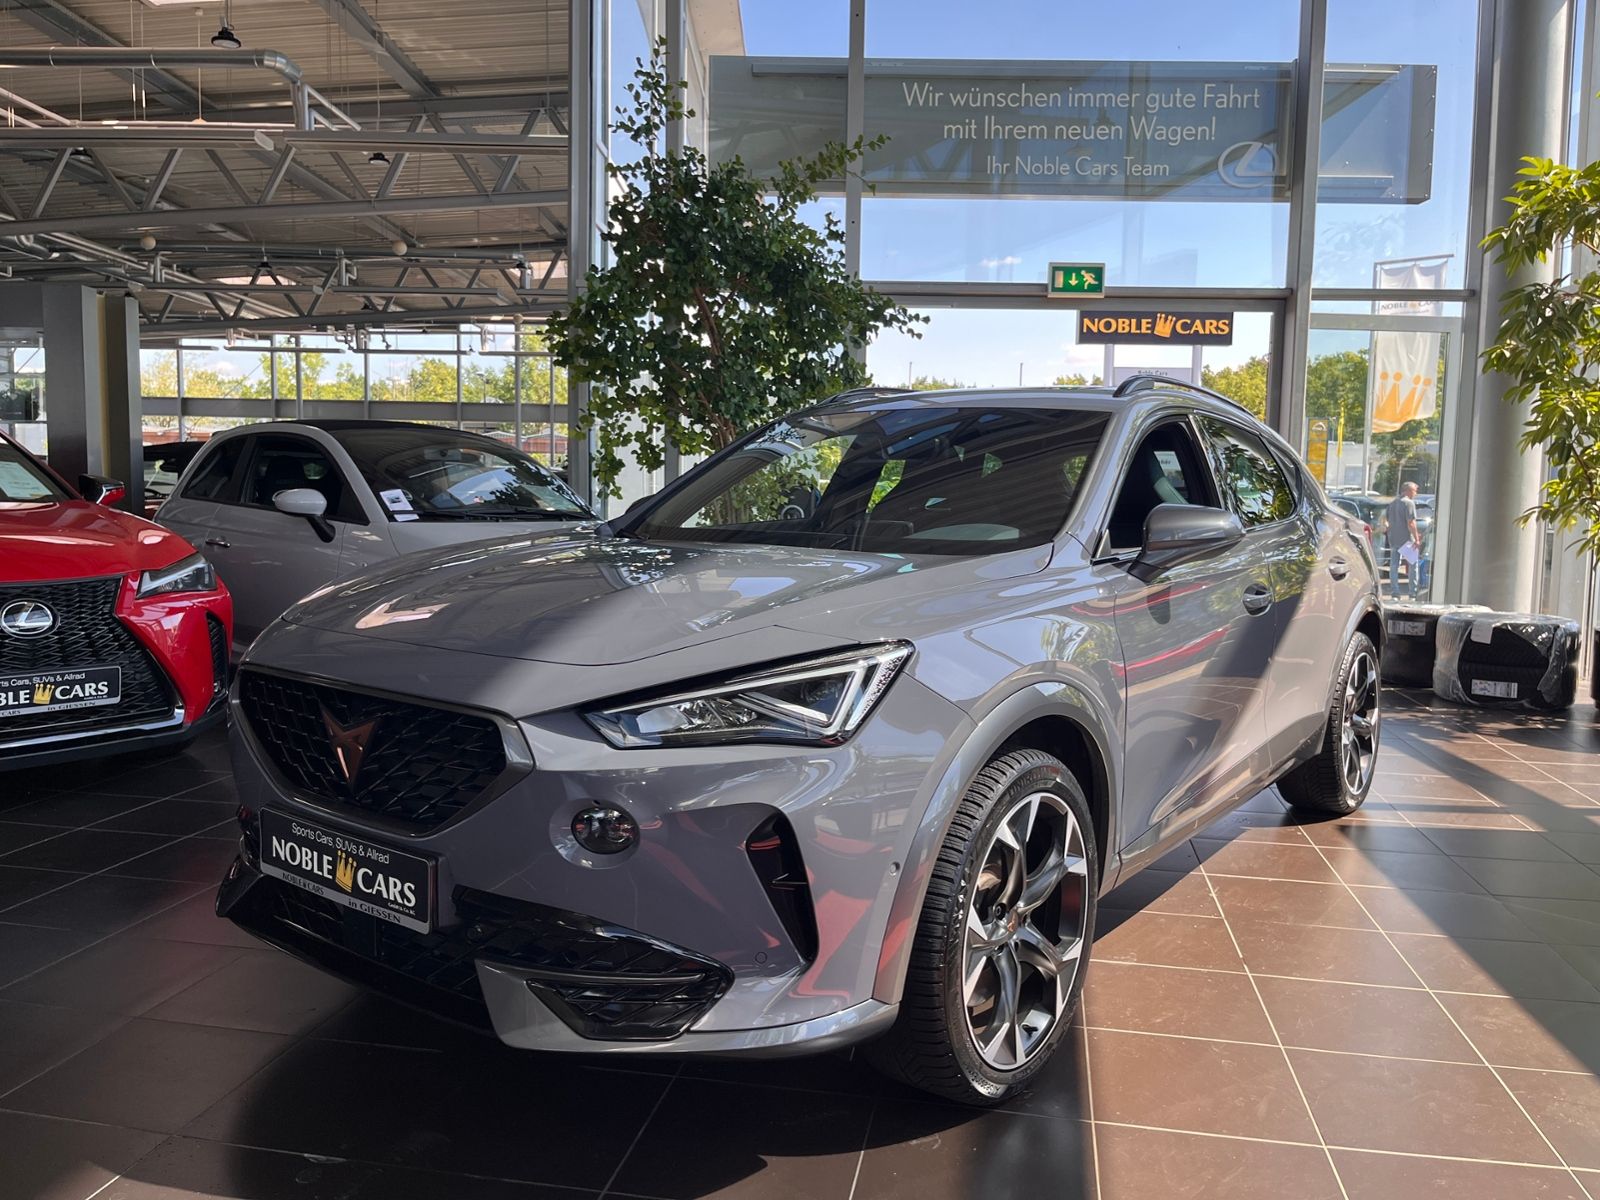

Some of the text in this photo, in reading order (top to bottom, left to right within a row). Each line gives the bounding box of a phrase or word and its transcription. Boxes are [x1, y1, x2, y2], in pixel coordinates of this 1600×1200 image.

[902, 82, 1261, 114] Wir wünschen immer gute Fahrt
[943, 115, 1217, 147] mit Ihrem neuen Wagen!
[987, 155, 1170, 177] Ihr Noble Cars Team
[1082, 317, 1230, 335] NOBLE CARS
[10, 678, 32, 687] Cars,
[33, 675, 55, 685] SUVs
[56, 674, 63, 682] &
[64, 672, 86, 681] Allrad
[0, 681, 109, 707] BLE CARS
[291, 822, 390, 865] Sports Cars, SUVs & Allrad
[272, 835, 417, 908] NOBLE CARS
[359, 903, 401, 924] GIESSEN
